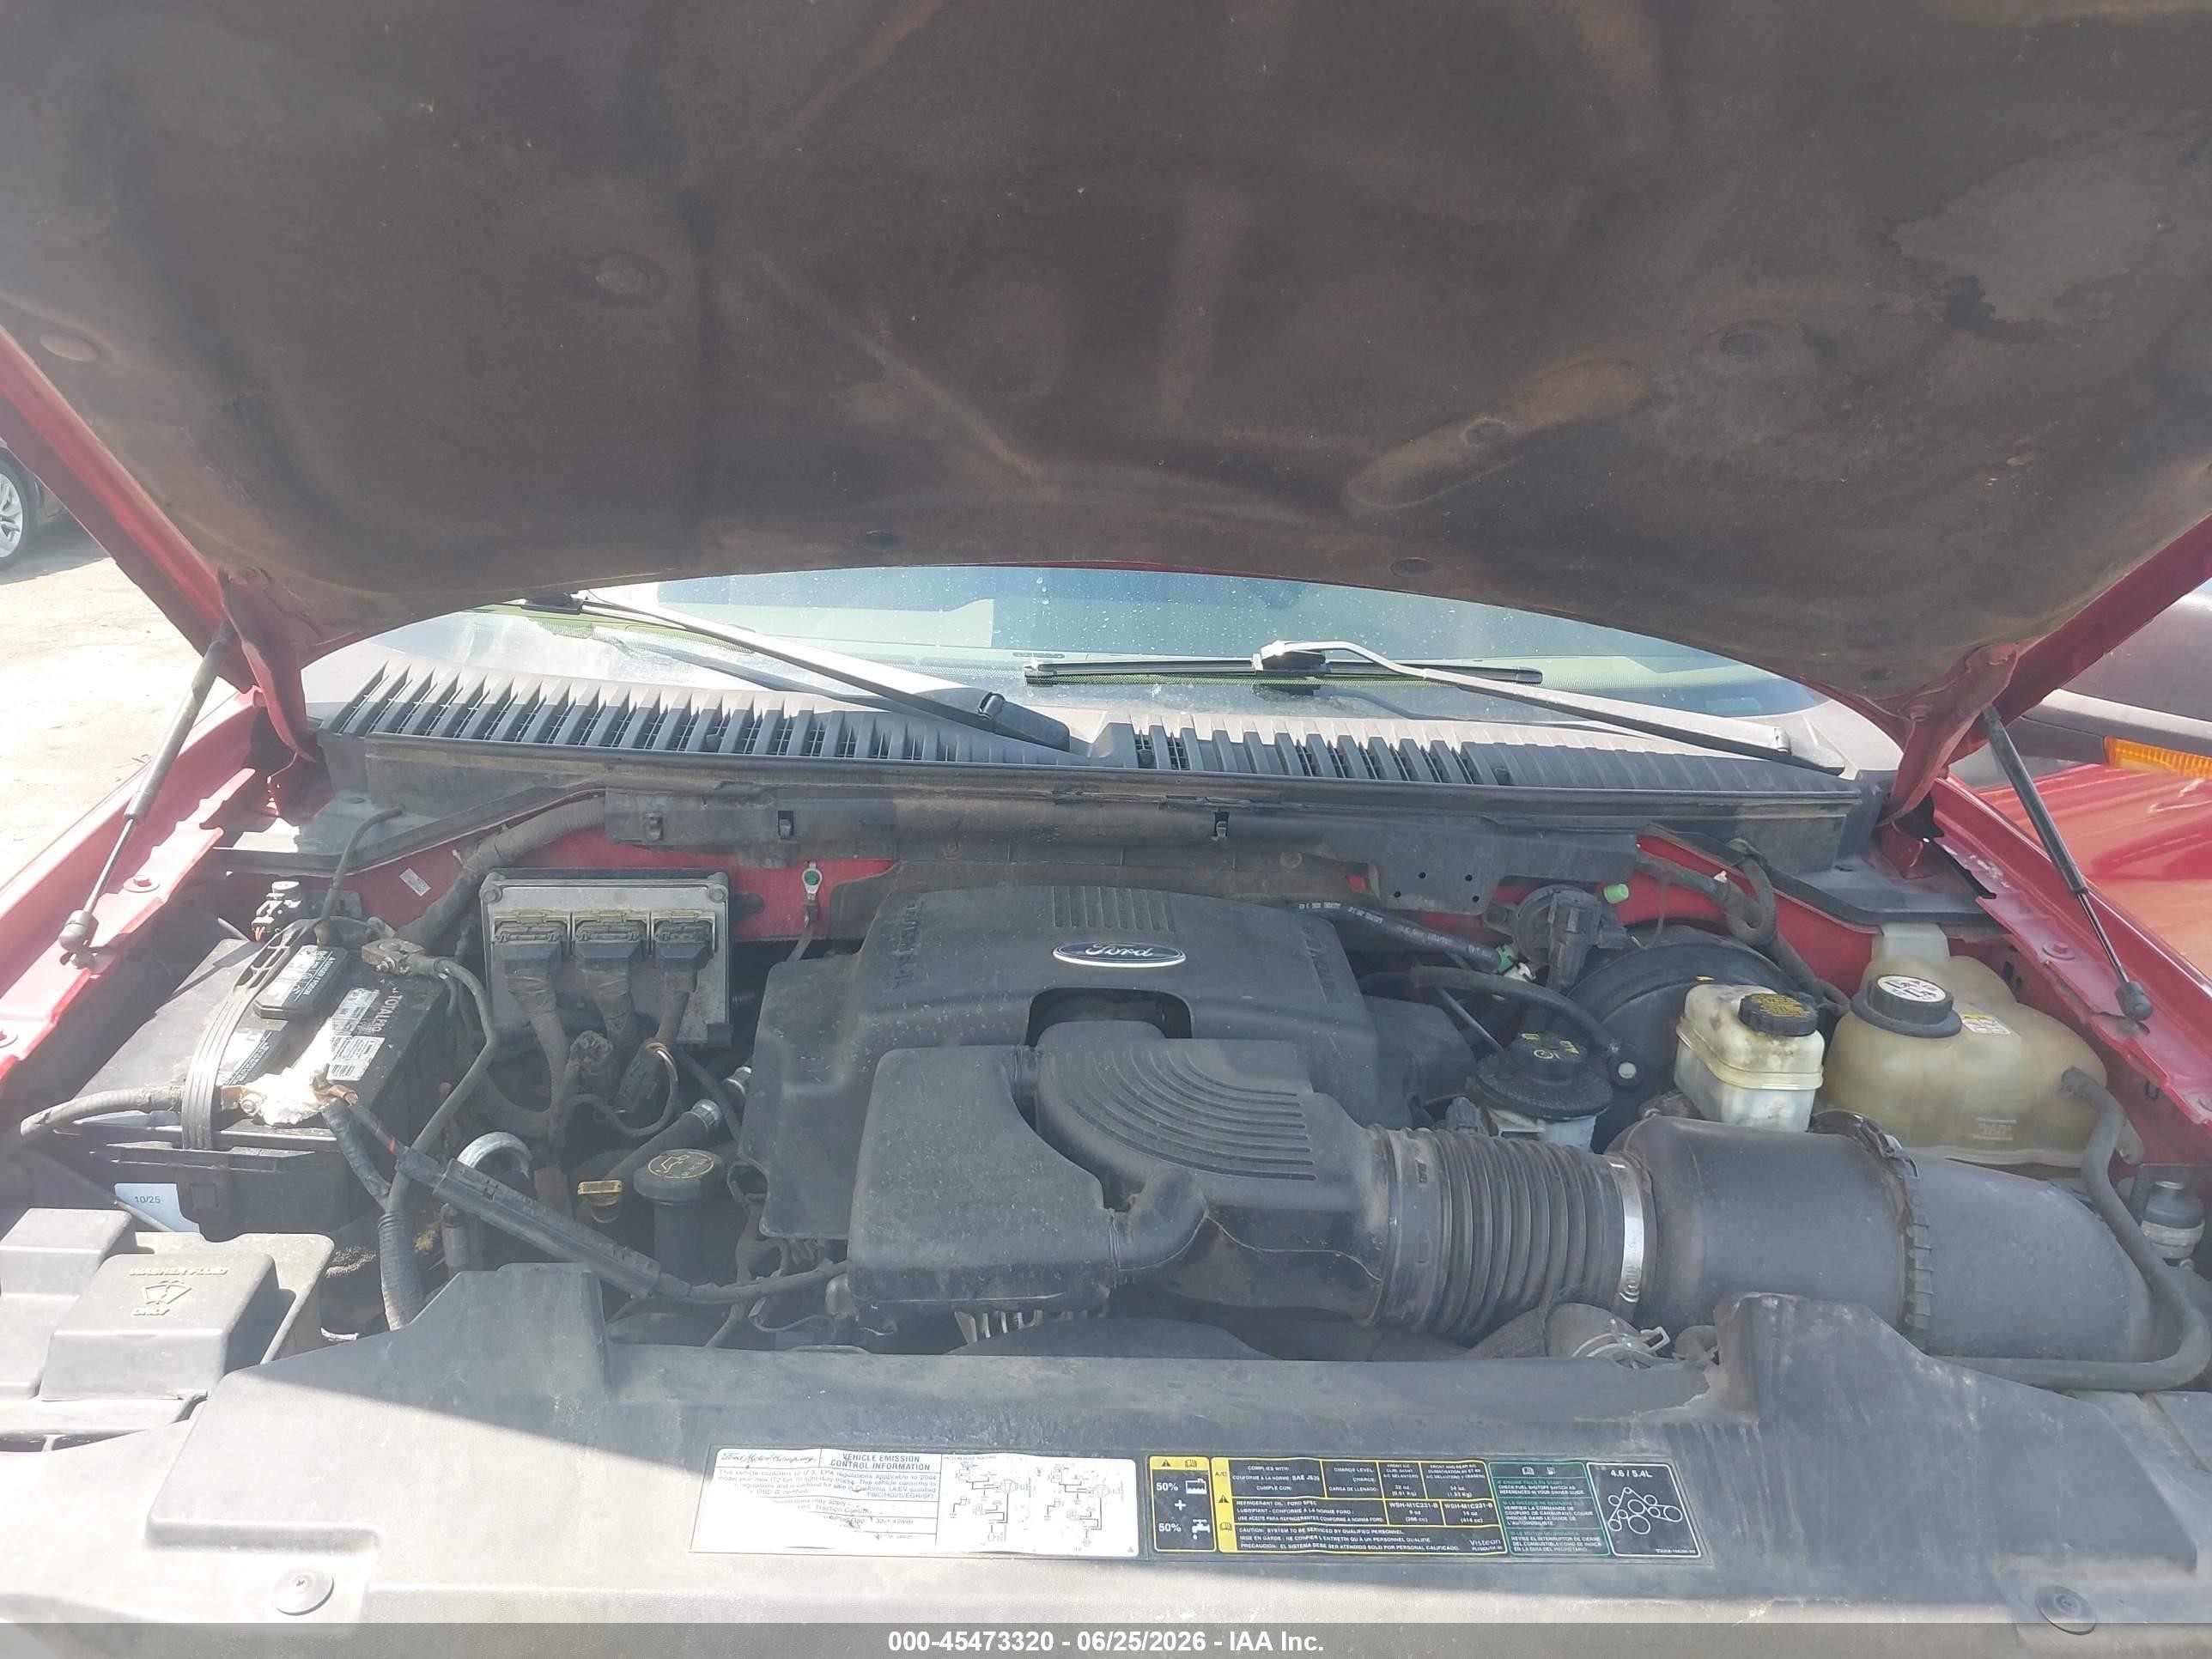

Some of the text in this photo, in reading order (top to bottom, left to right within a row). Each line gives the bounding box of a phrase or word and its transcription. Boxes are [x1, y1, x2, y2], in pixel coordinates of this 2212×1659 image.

[1085, 944, 1154, 957] Ford
[842, 1453, 876, 1462] VEHICLE
[830, 1460, 930, 1471] CONTROL INFORMATION
[1611, 1469, 1625, 1478] 4.6
[1156, 1482, 1179, 1492] 50%
[1158, 1523, 1182, 1533] 50%
